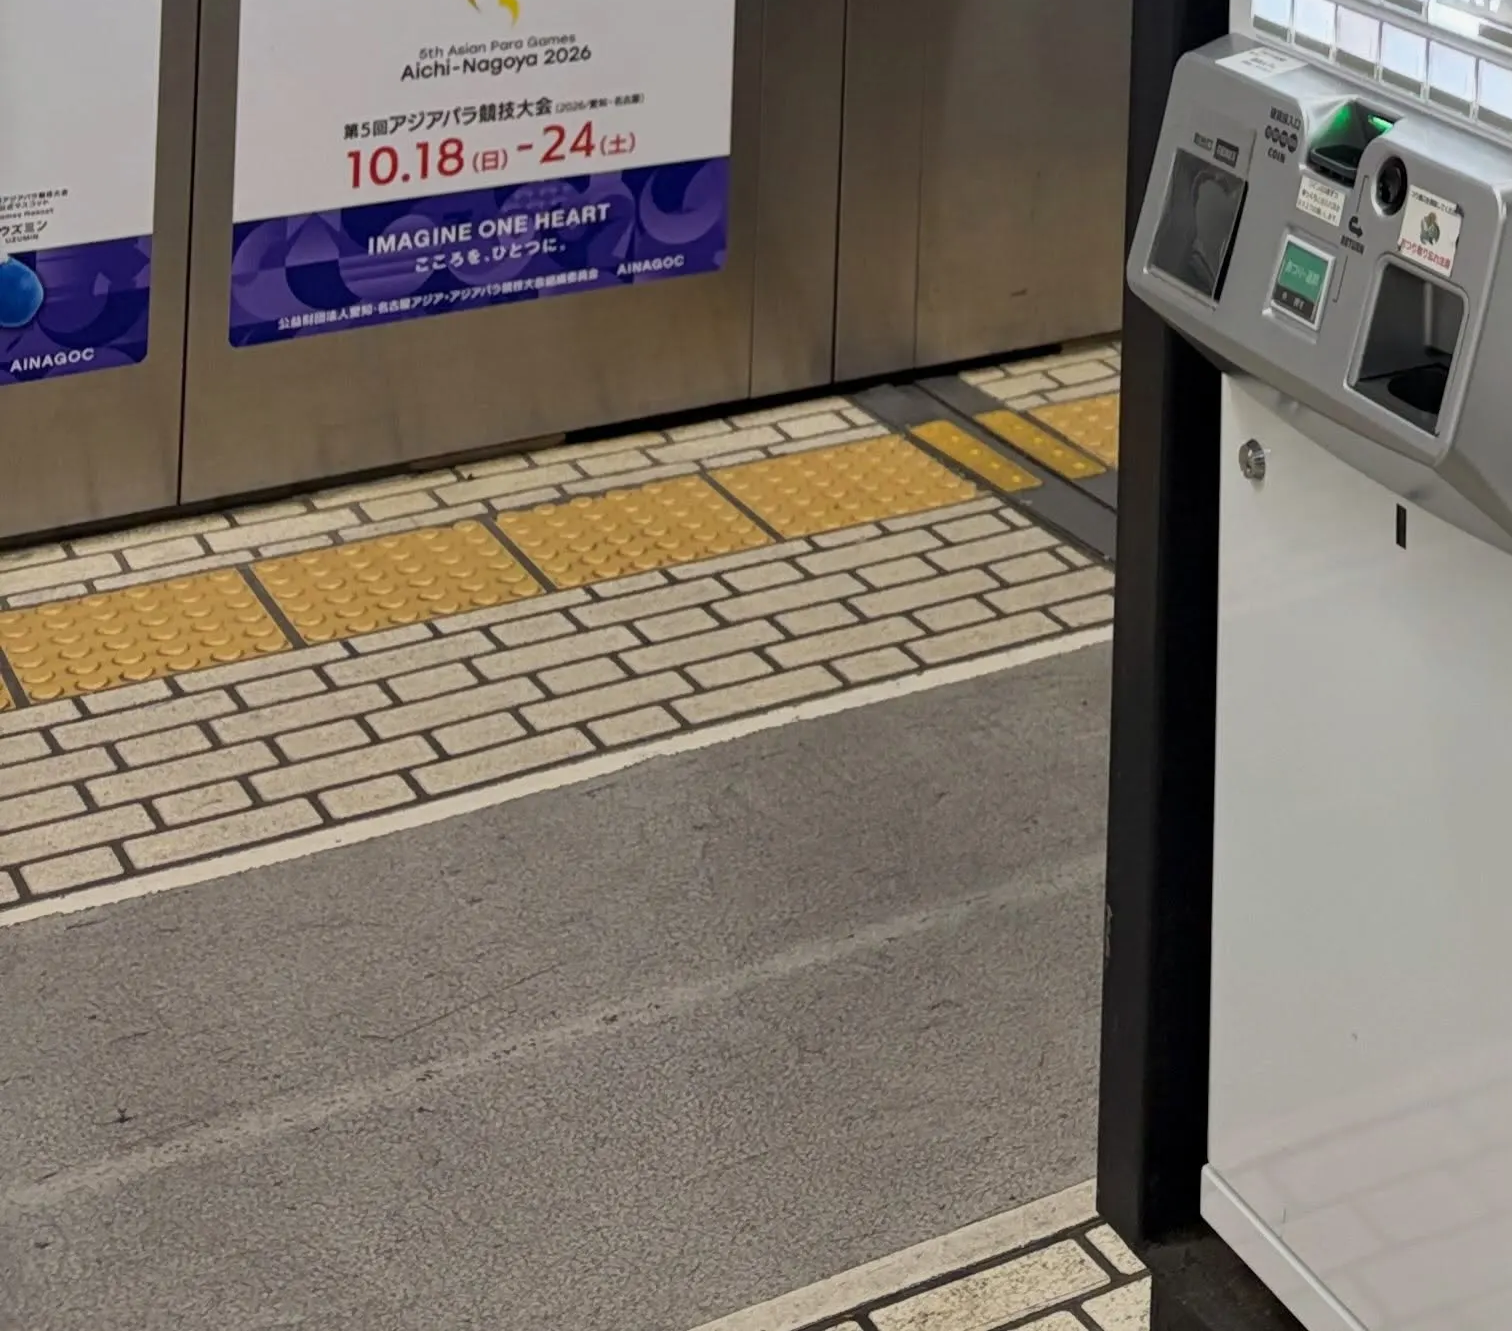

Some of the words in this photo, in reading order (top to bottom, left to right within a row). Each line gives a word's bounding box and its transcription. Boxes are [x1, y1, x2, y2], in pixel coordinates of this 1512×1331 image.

[419, 47, 444, 60] 5th
[448, 42, 486, 57] Asian
[491, 38, 523, 52] Para
[527, 33, 576, 48] Games
[400, 52, 538, 82] Aichi-Nagoya
[544, 45, 592, 64] 2026
[344, 97, 552, 139] 第5回アジアパラ競技大会
[368, 222, 472, 256] IMAGINE
[478, 216, 529, 239] ONE
[534, 203, 611, 231] HEART
[616, 255, 685, 276] AINAGOC
[10, 348, 95, 373] AINAGOC
